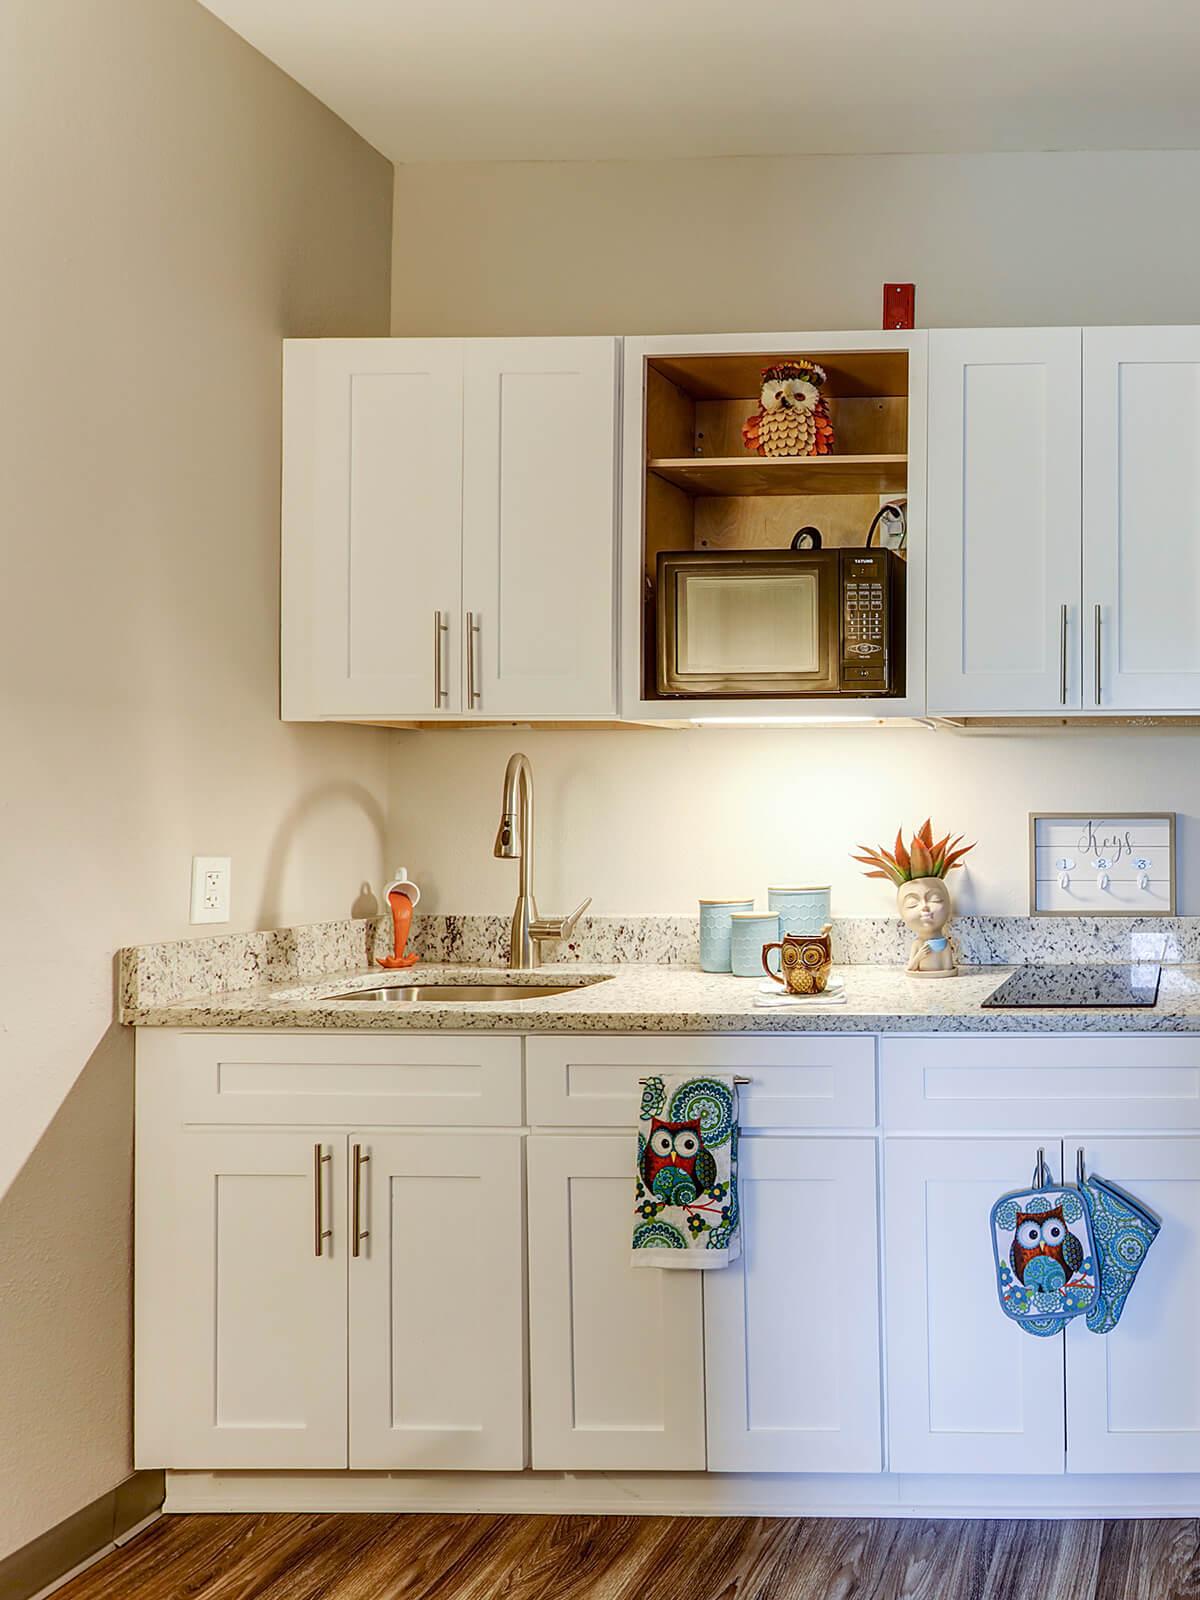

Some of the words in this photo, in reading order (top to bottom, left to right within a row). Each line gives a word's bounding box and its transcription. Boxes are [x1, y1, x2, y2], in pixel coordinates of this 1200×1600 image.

[1078, 820, 1135, 863] Keys
[1061, 859, 1068, 869] 1
[1097, 859, 1107, 869] 2
[1137, 859, 1147, 870] 3
